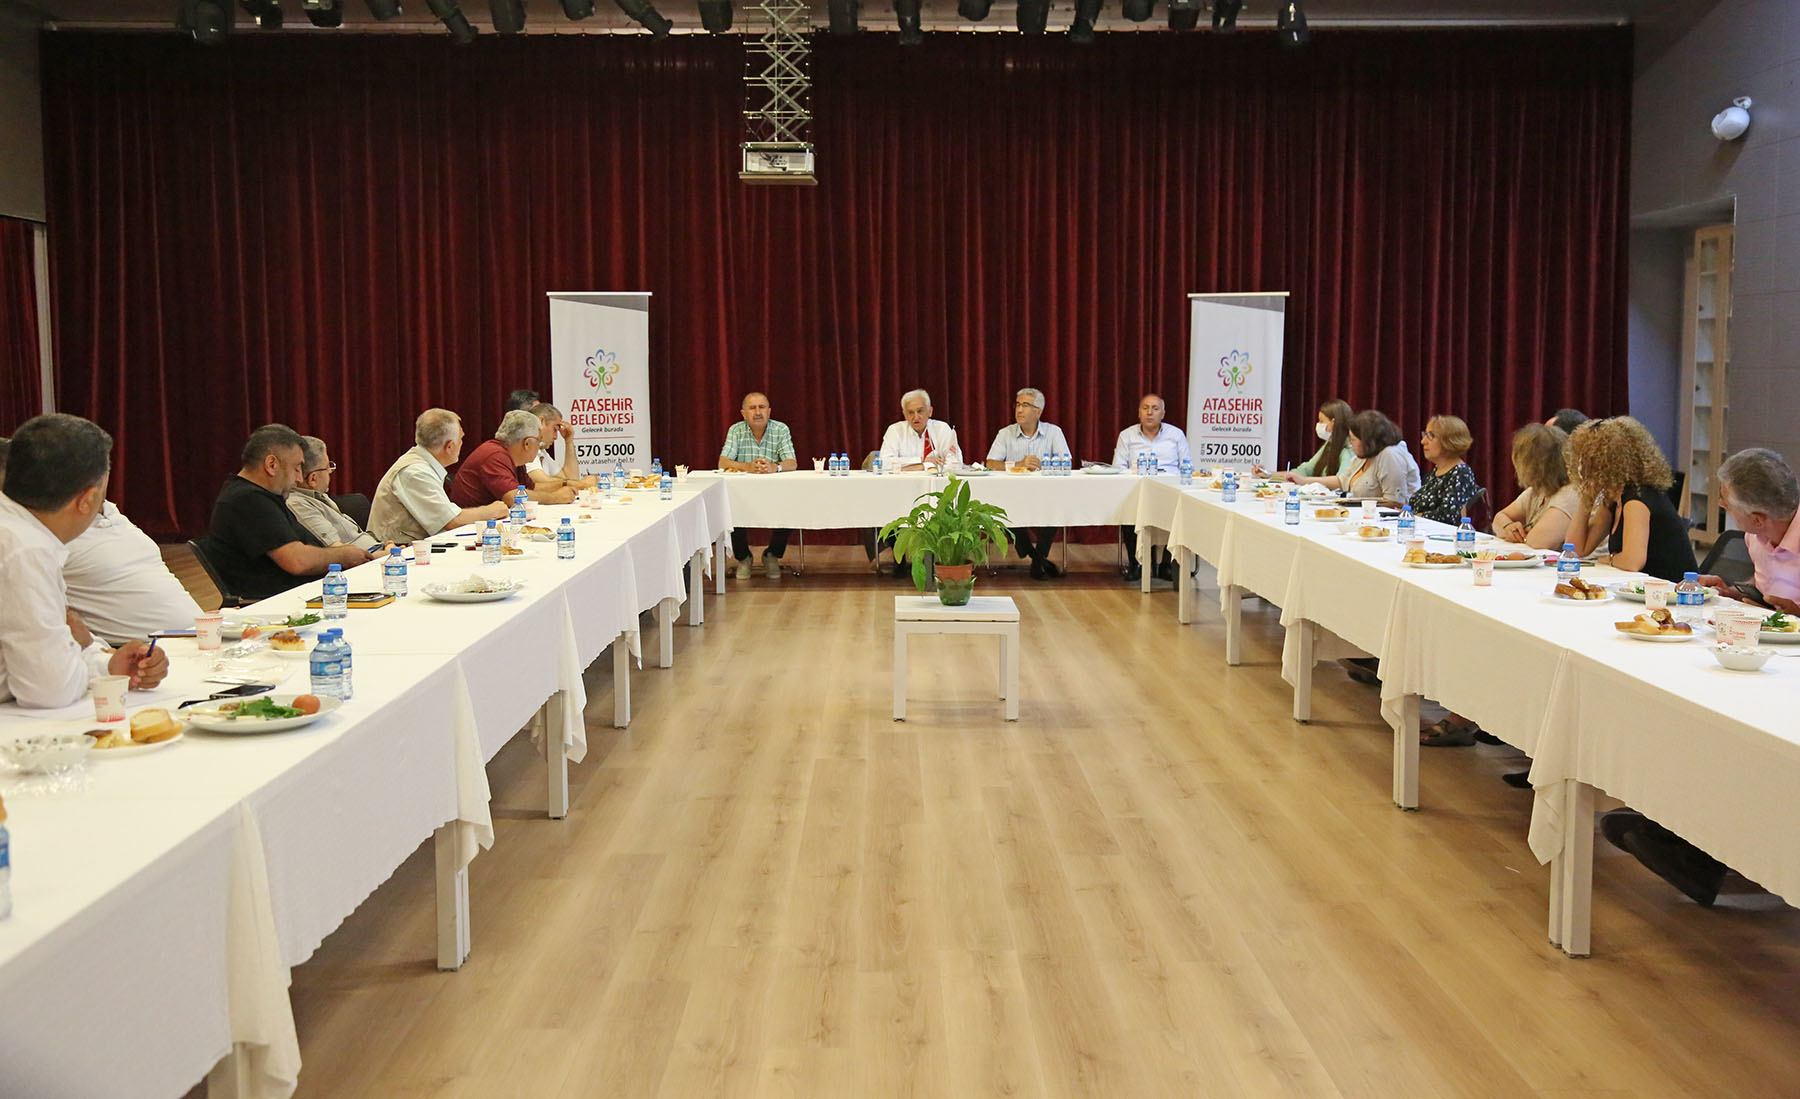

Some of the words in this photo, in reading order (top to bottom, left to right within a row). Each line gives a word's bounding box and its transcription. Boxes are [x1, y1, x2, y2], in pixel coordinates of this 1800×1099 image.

[577, 444, 601, 457] 570
[604, 443, 635, 456] 5000
[1206, 443, 1228, 456] 570
[1231, 444, 1261, 456] 5000
